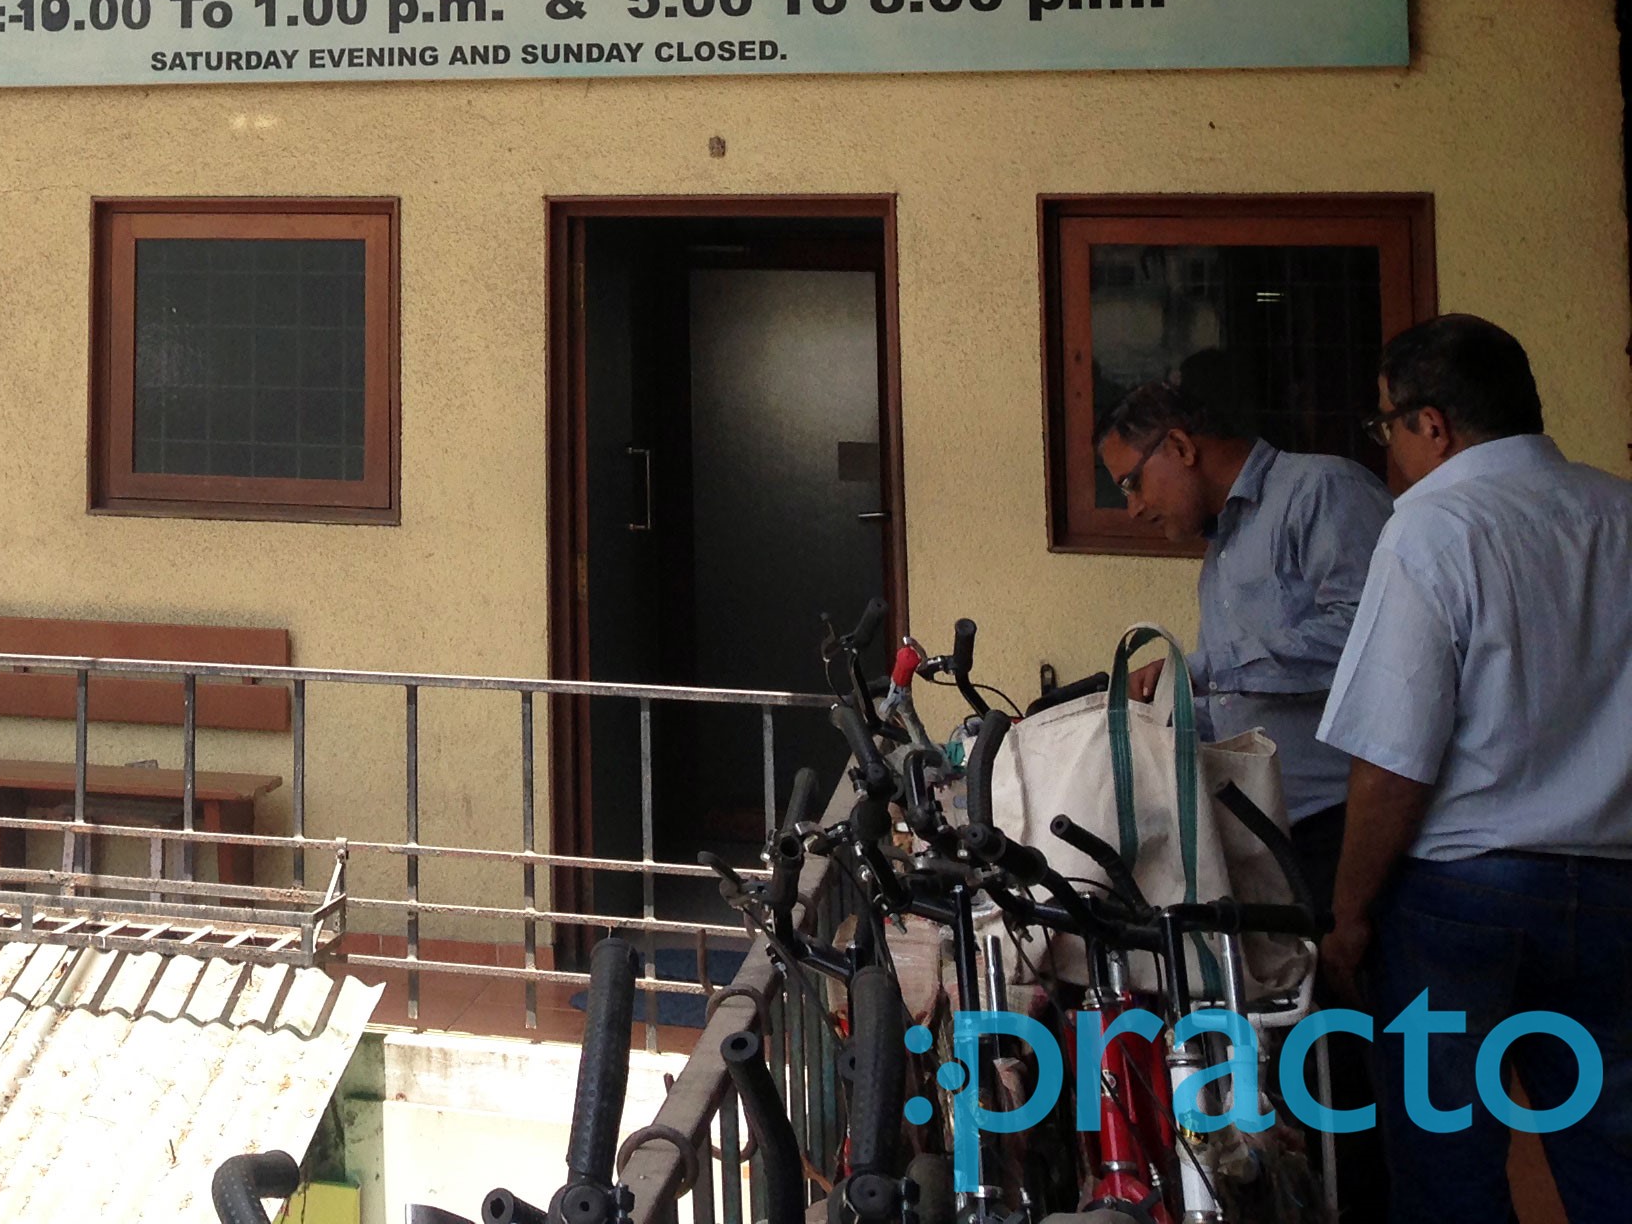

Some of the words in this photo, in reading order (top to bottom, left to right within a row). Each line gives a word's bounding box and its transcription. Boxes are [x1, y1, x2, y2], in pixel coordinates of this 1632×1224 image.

[150, 48, 300, 72] SATURDAY
[309, 46, 441, 69] EVENING
[448, 44, 511, 66] AND
[520, 42, 645, 65] SUNDAY
[654, 40, 788, 64] CLOSED.
